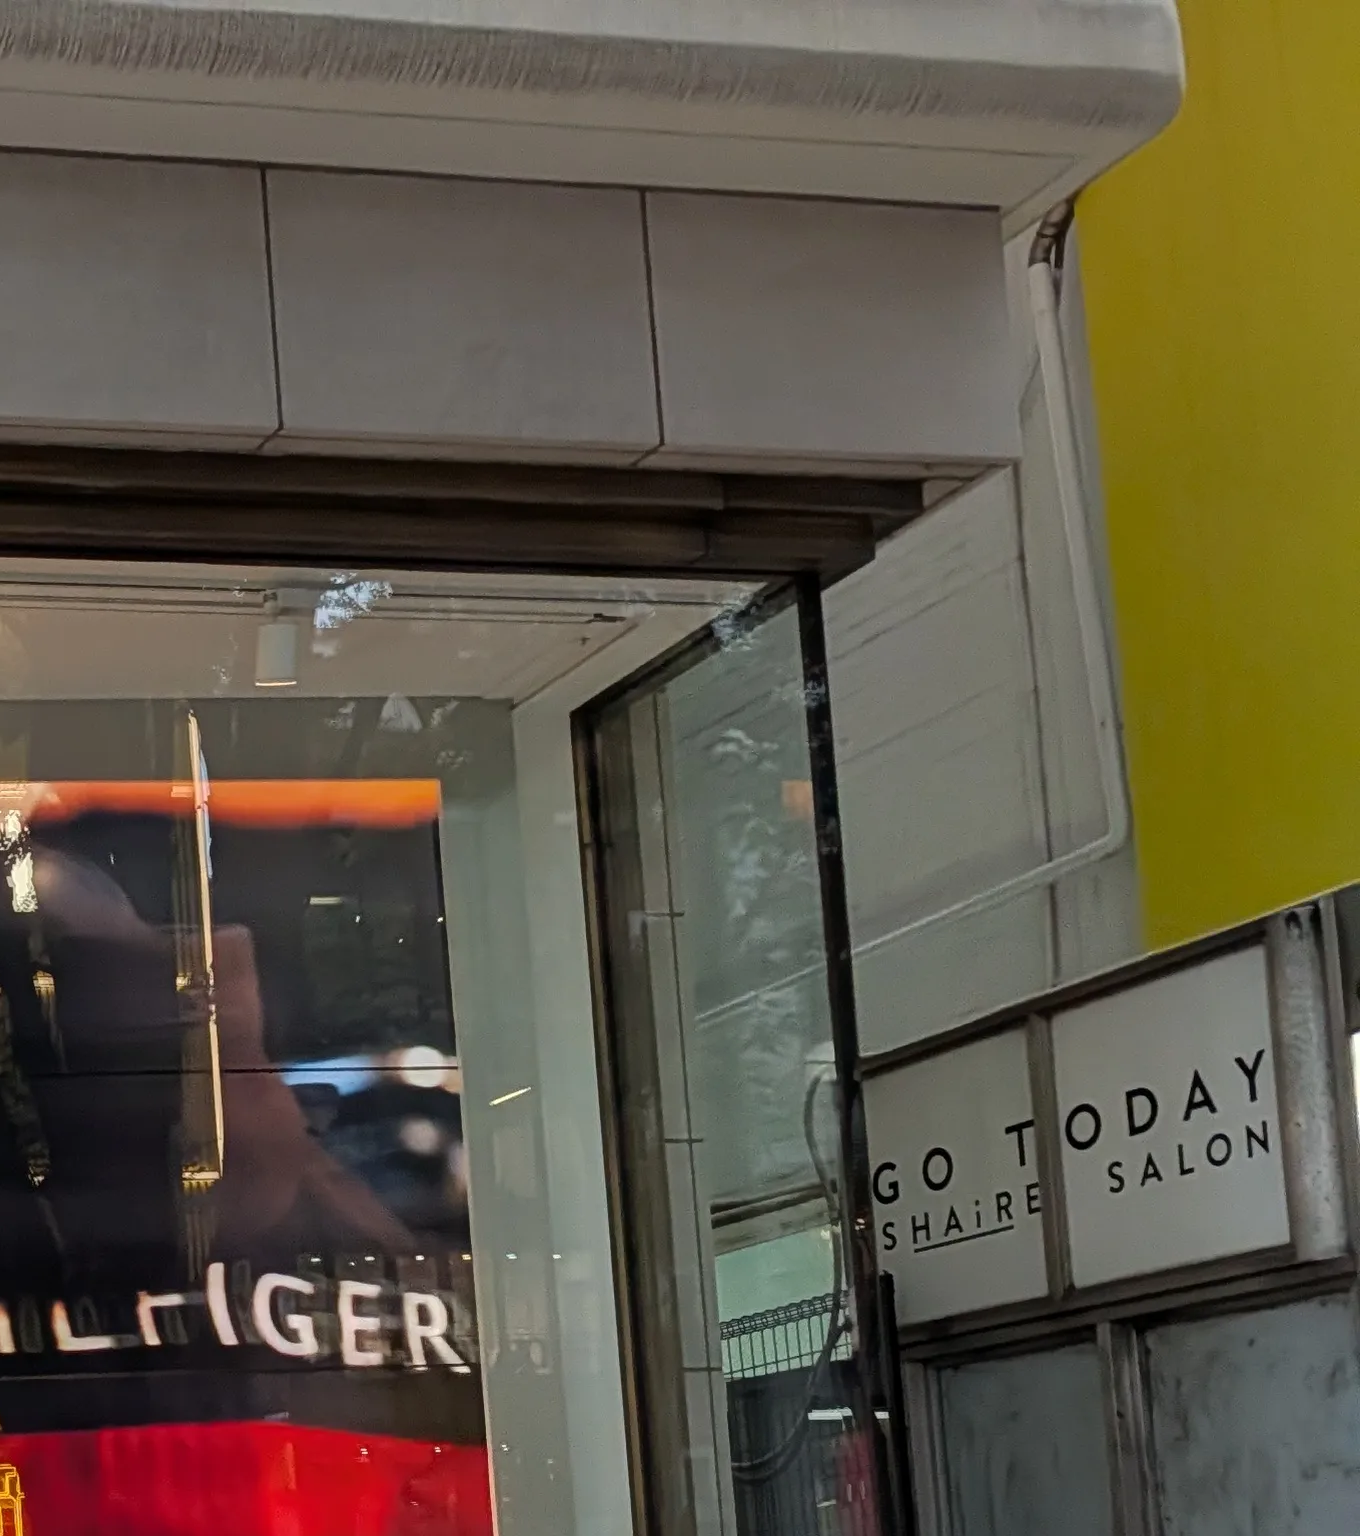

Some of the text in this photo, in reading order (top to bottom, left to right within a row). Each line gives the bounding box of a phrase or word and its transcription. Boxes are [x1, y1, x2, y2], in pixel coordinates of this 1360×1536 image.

[872, 1048, 1265, 1204] GO TODAY
[1107, 1120, 1270, 1194] SALON
